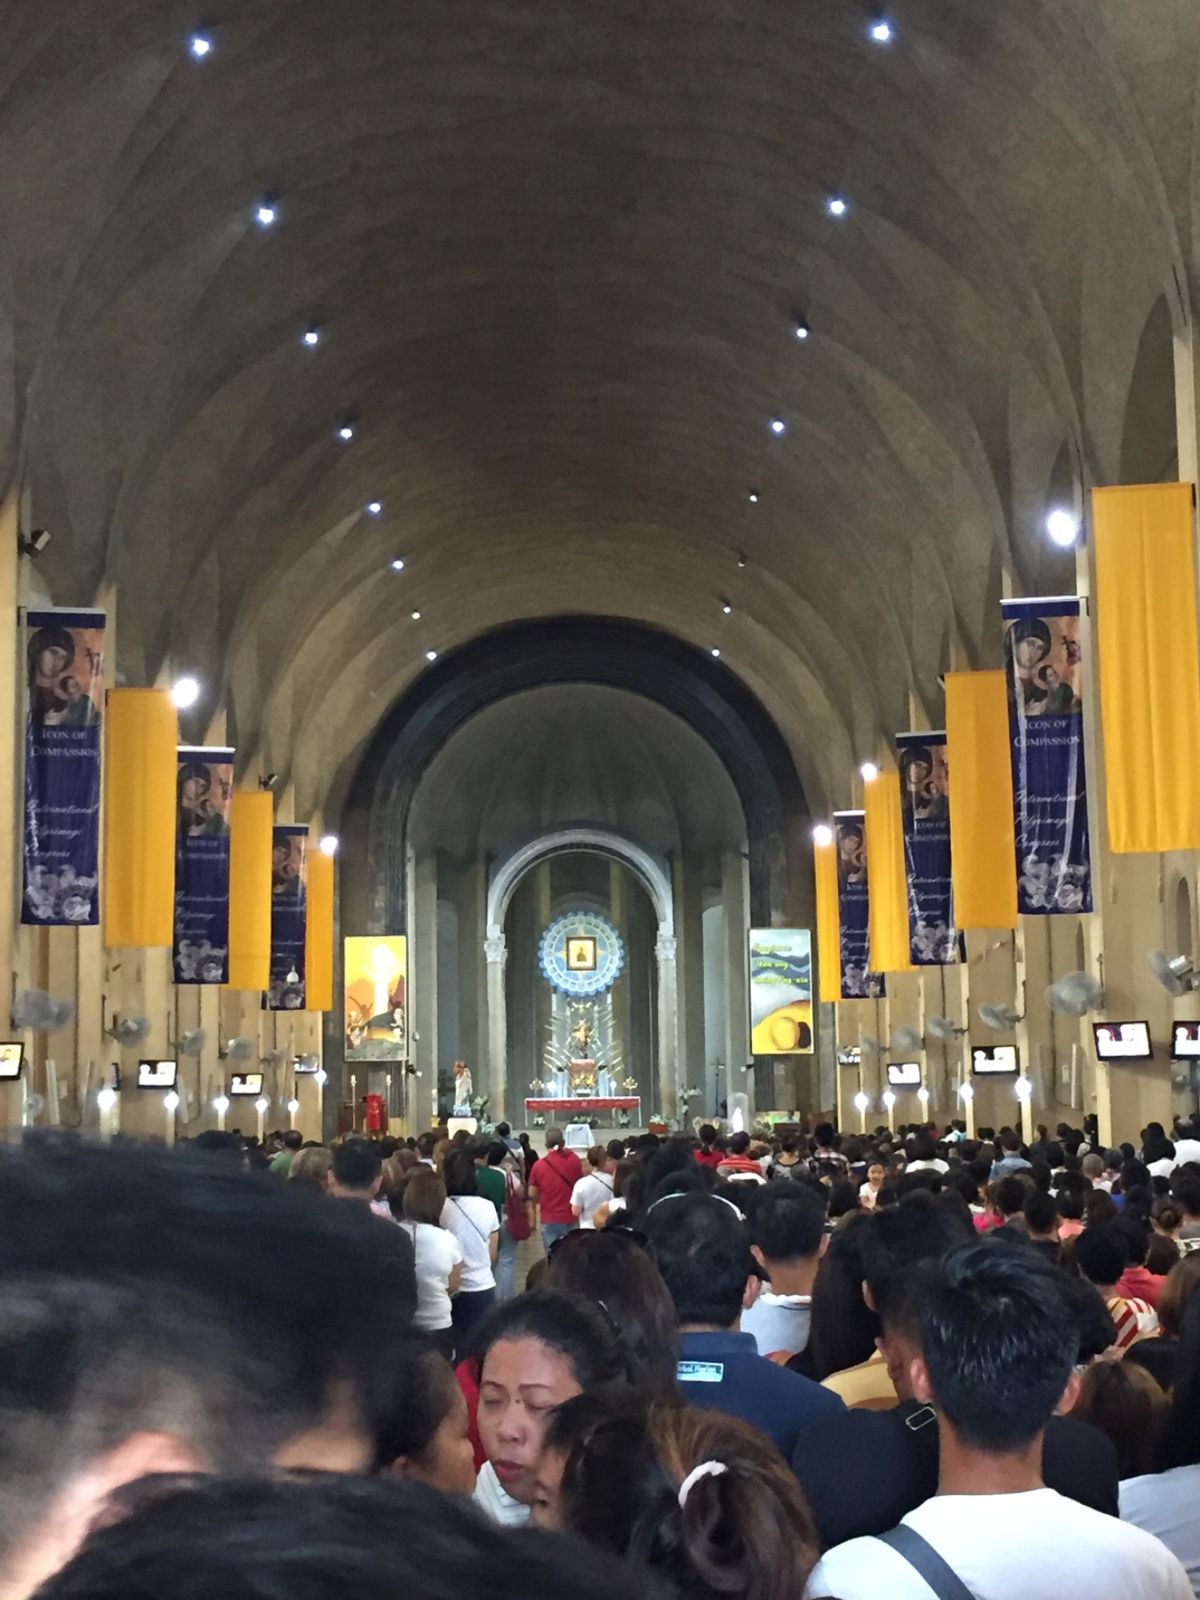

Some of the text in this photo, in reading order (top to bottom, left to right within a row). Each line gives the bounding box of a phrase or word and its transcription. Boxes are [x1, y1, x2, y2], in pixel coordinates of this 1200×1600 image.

[1052, 718, 1069, 729] OF
[42, 728, 88, 740] ICON OF
[1014, 736, 1080, 748] COMPASSION
[31, 747, 98, 758] COMPASSION
